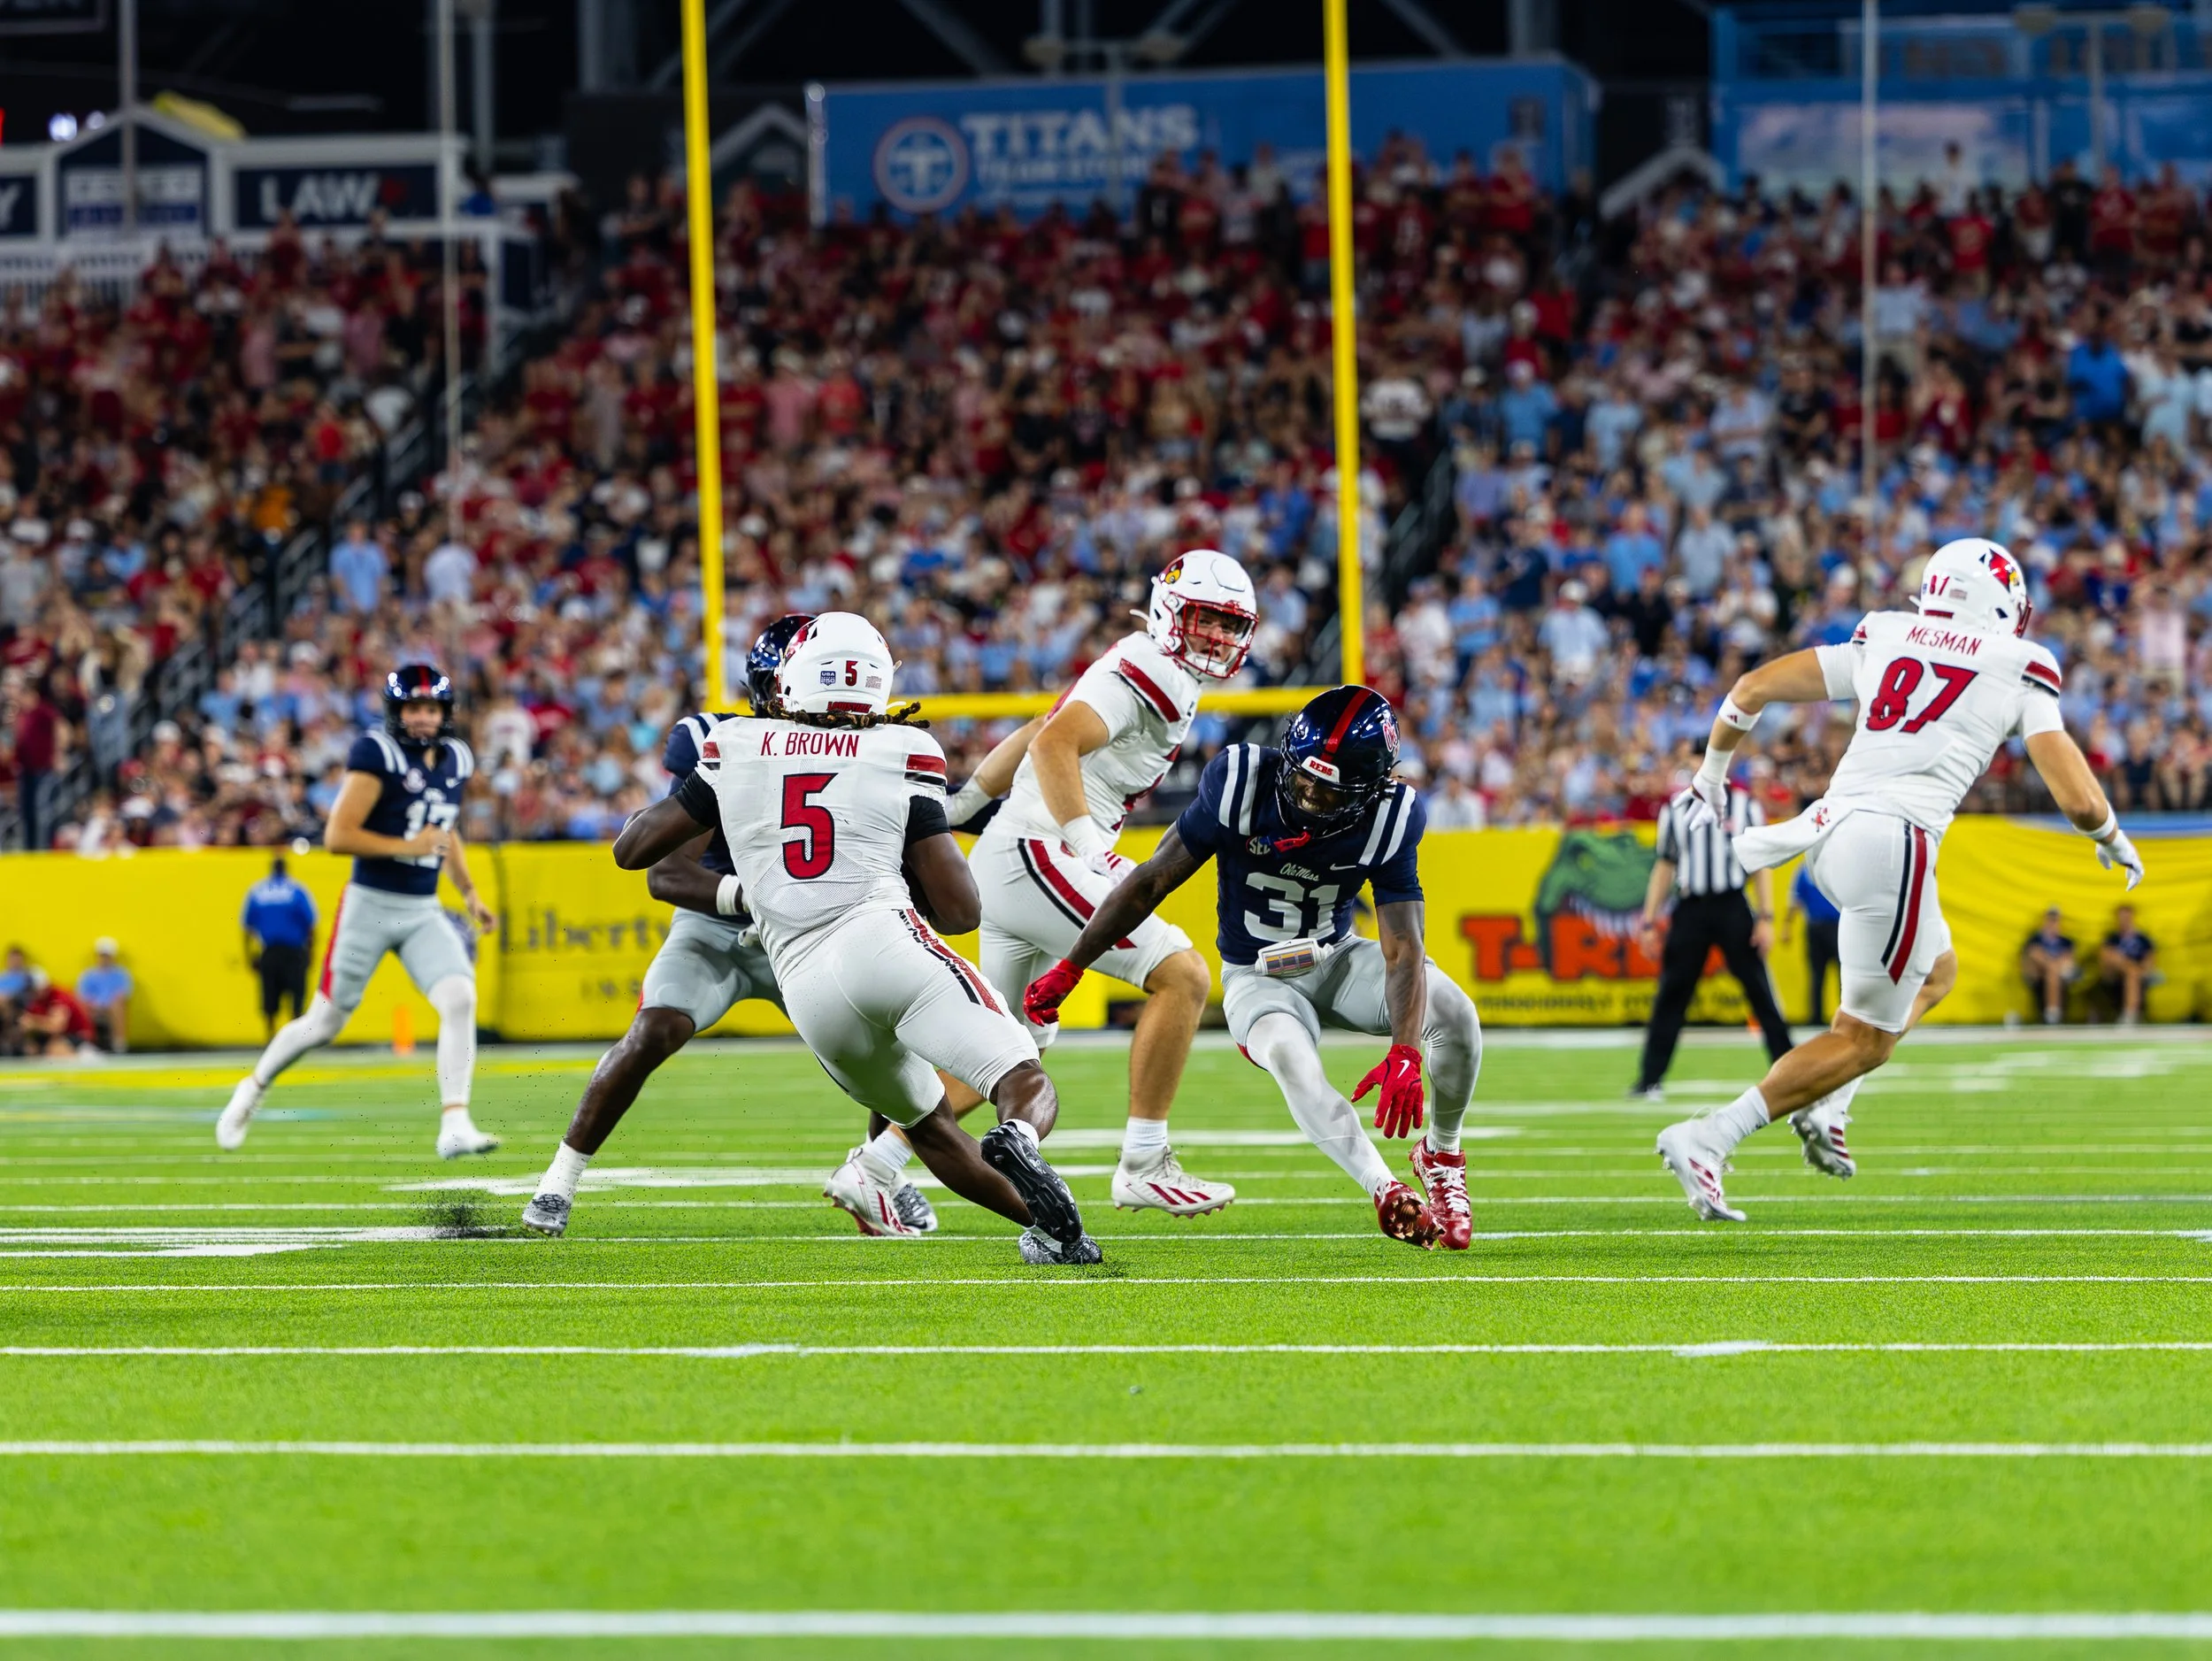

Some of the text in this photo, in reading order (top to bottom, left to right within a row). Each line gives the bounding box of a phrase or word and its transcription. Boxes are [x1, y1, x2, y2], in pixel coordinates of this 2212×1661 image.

[961, 104, 1200, 152] TITANS
[261, 172, 383, 219] LAW
[1906, 625, 1982, 657] MESMAN
[844, 659, 858, 687] 5
[1865, 656, 1979, 734] 87
[760, 731, 860, 757] K. BROWN
[1310, 759, 1334, 777] REBS
[780, 772, 839, 880] 5
[1244, 872, 1340, 943] 31
